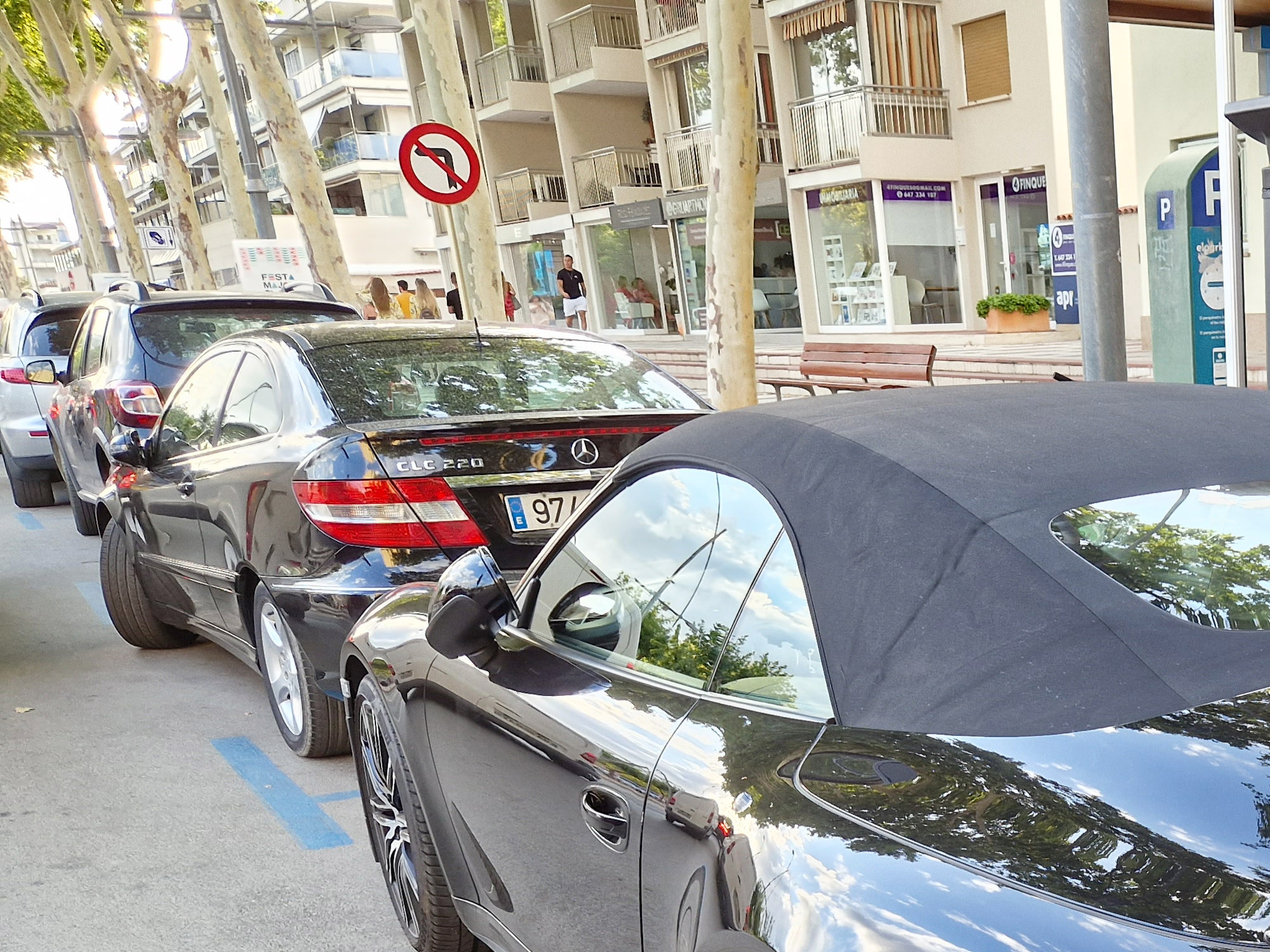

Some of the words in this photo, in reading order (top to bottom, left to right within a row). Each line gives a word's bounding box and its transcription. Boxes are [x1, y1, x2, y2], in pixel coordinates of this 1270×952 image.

[1160, 198, 1171, 221] P
[397, 460, 436, 472] CLC
[443, 457, 485, 469] 220
[516, 516, 524, 525] E
